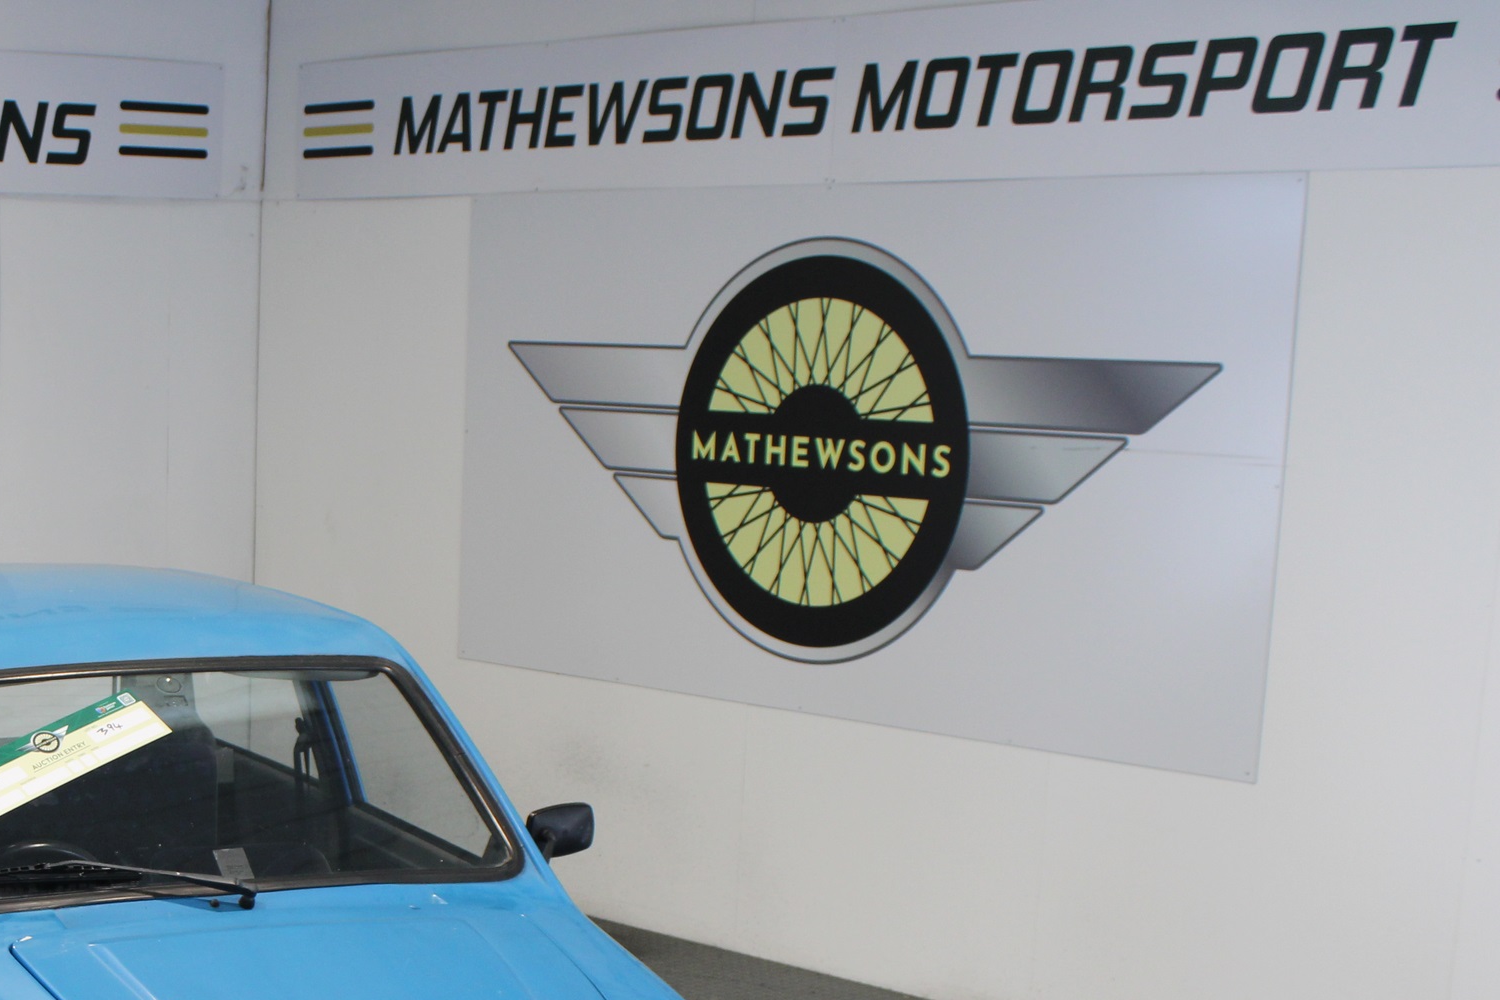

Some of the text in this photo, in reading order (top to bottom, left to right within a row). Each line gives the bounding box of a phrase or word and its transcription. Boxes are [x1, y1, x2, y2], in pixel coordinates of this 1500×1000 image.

[394, 21, 1458, 155] MATHEWSONS MOTORSPORT
[691, 429, 952, 478] MATHEWSONS
[97, 722, 123, 736] 394
[32, 752, 64, 770] AUCTION
[64, 741, 86, 755] ENTRY
